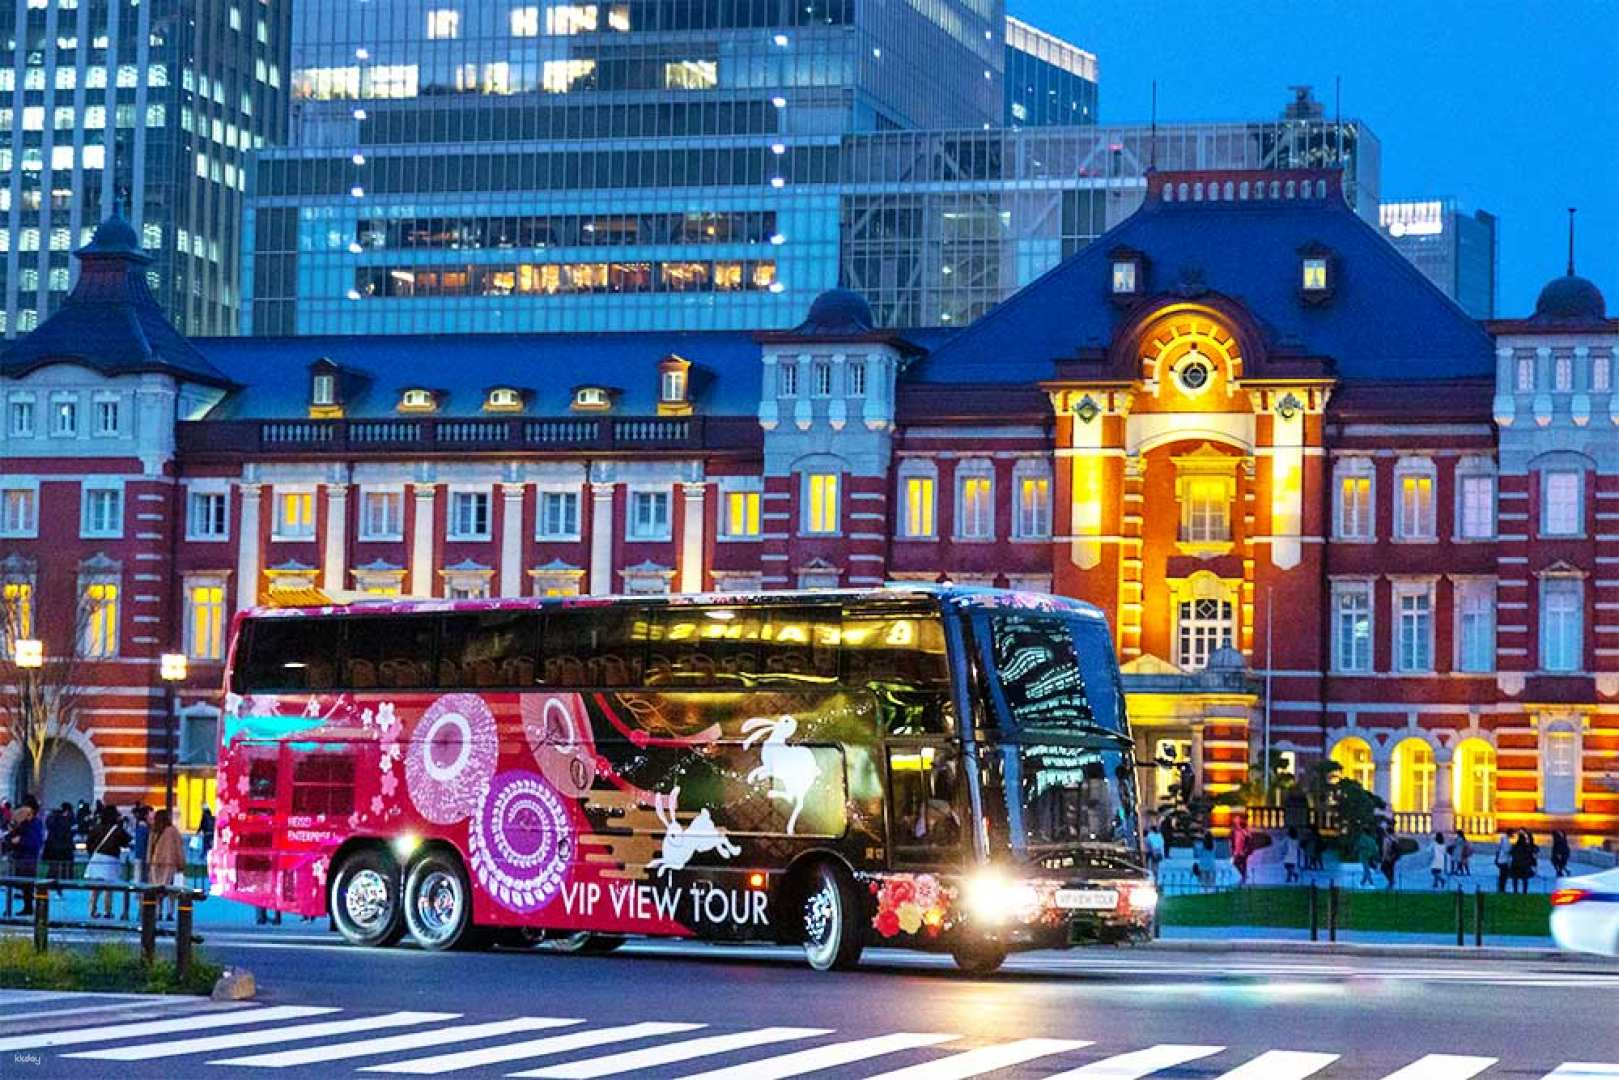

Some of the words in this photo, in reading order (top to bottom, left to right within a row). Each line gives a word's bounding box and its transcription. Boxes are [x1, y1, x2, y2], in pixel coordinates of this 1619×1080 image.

[560, 881, 600, 916] VIP
[609, 883, 682, 921] VIEW
[690, 888, 769, 925] TOUR
